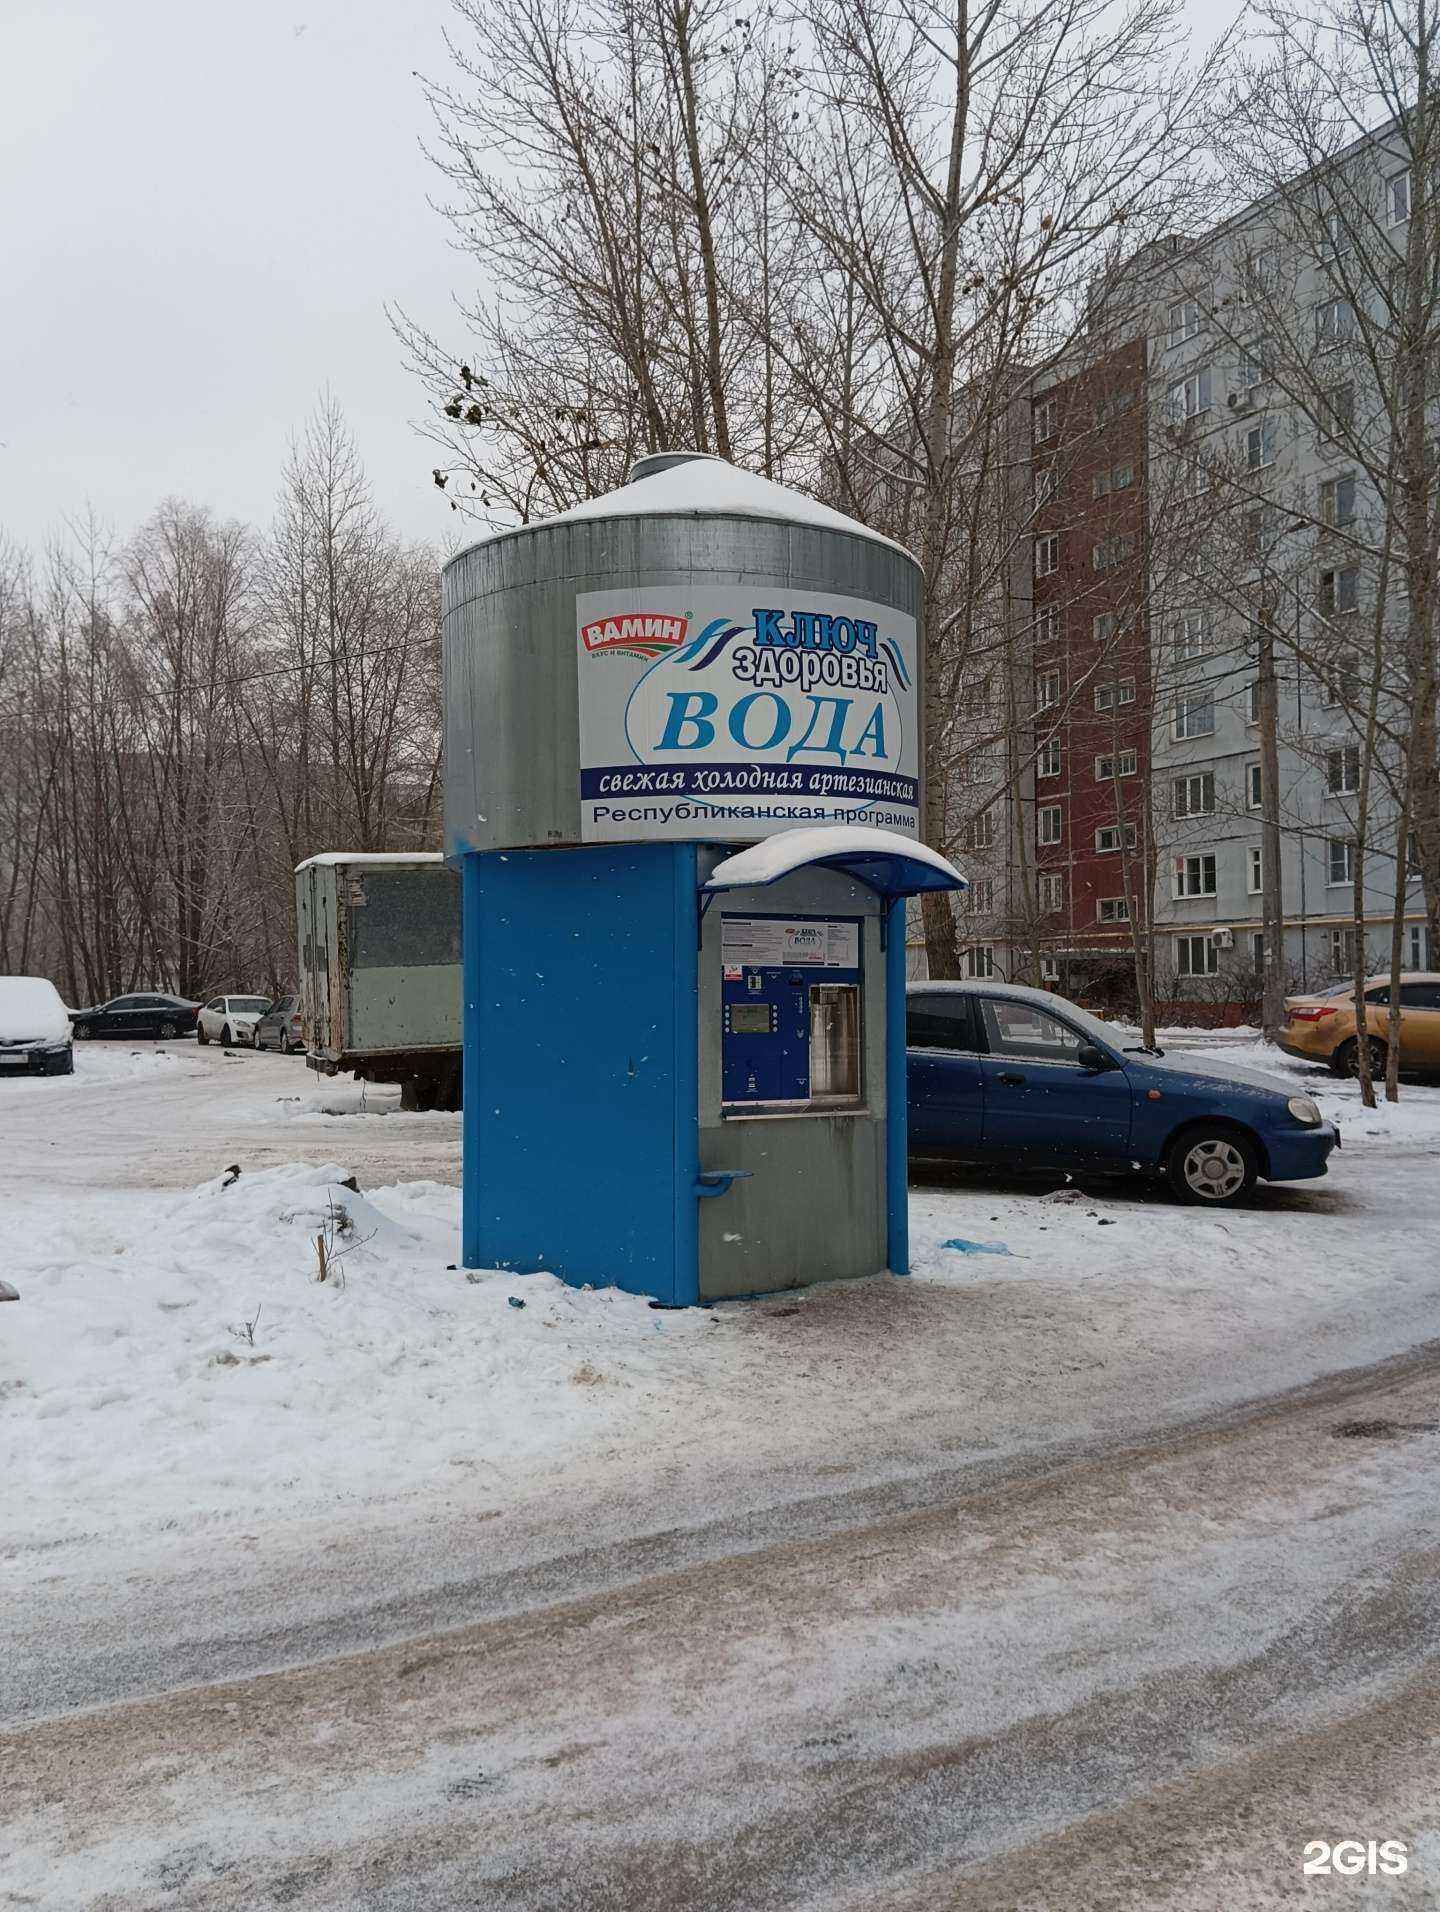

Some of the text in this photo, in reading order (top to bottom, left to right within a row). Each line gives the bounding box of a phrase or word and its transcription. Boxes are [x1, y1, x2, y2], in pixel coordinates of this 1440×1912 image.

[587, 618, 682, 646] ВАМИН
[752, 609, 878, 659] КЛЮЧ
[653, 691, 888, 766] ВОДА
[599, 764, 914, 801] свежая холодная артезианская
[592, 803, 916, 829] Республиканская программа
